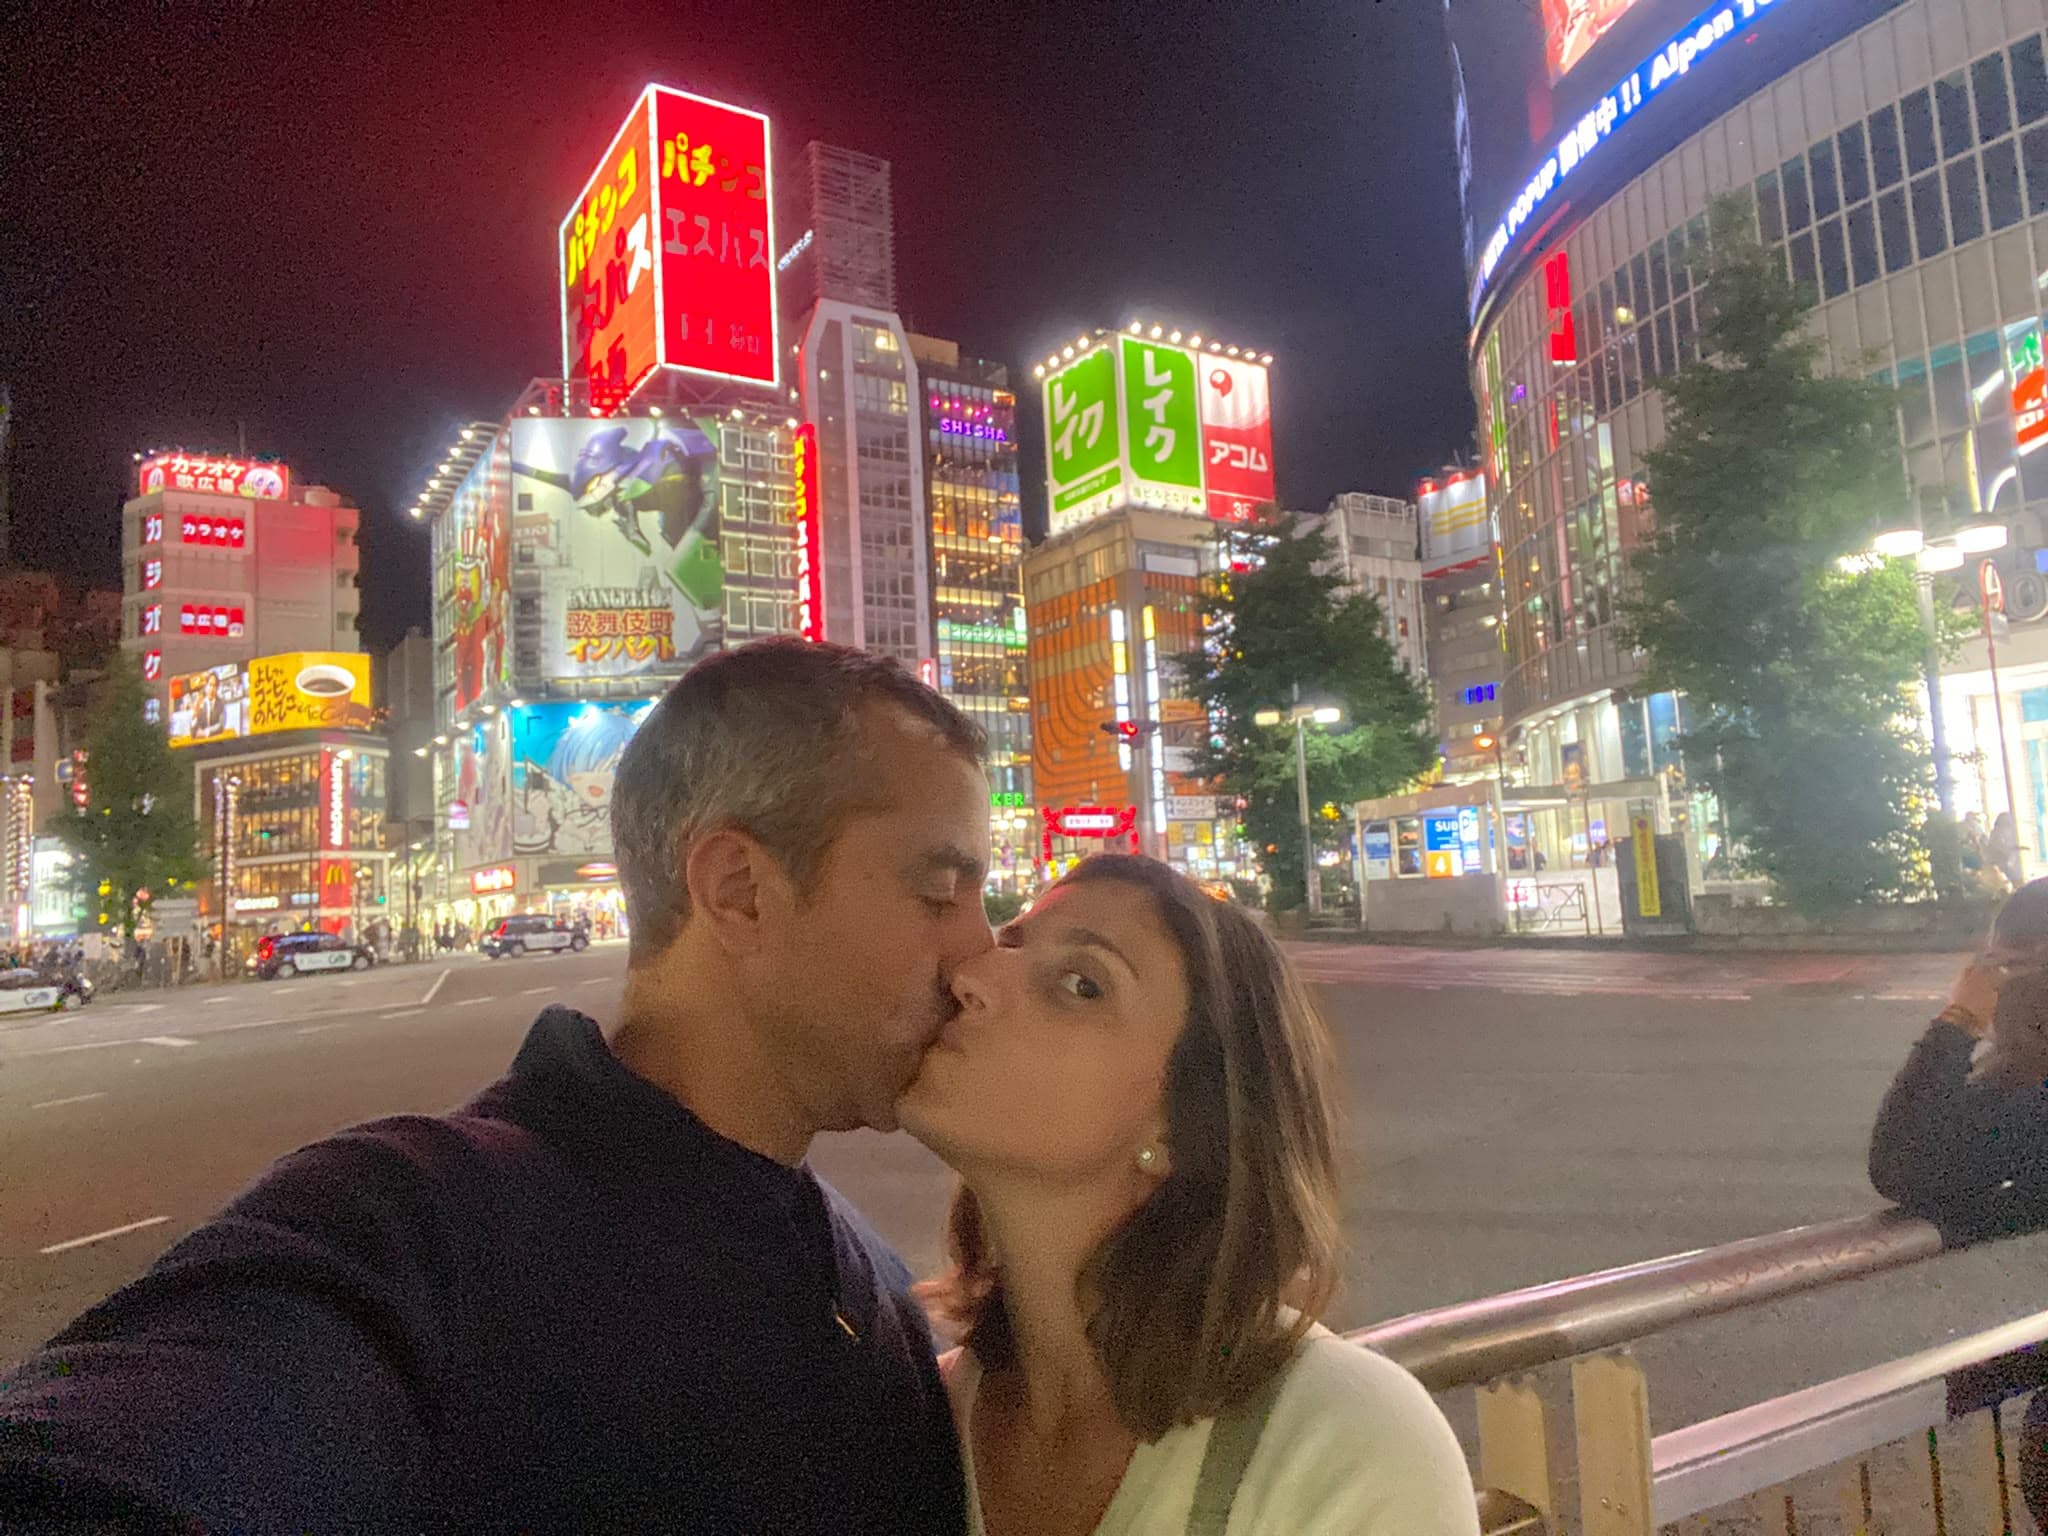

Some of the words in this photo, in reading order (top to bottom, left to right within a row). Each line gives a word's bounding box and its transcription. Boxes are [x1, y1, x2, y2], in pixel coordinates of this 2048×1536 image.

[1649, 8, 1734, 90] Alpen
[662, 131, 766, 201] パチンコ
[567, 146, 638, 287] パチンコ
[1142, 349, 1176, 463] レイク
[940, 417, 1007, 441] SHISHA
[1053, 382, 1105, 461] レイク
[170, 455, 246, 478] カラオケ
[1208, 439, 1268, 473] アコム
[182, 522, 244, 540] カラオケ
[566, 610, 675, 637] 歌舞伎町
[566, 637, 676, 662] インパクト
[1434, 820, 1458, 832] SUB
